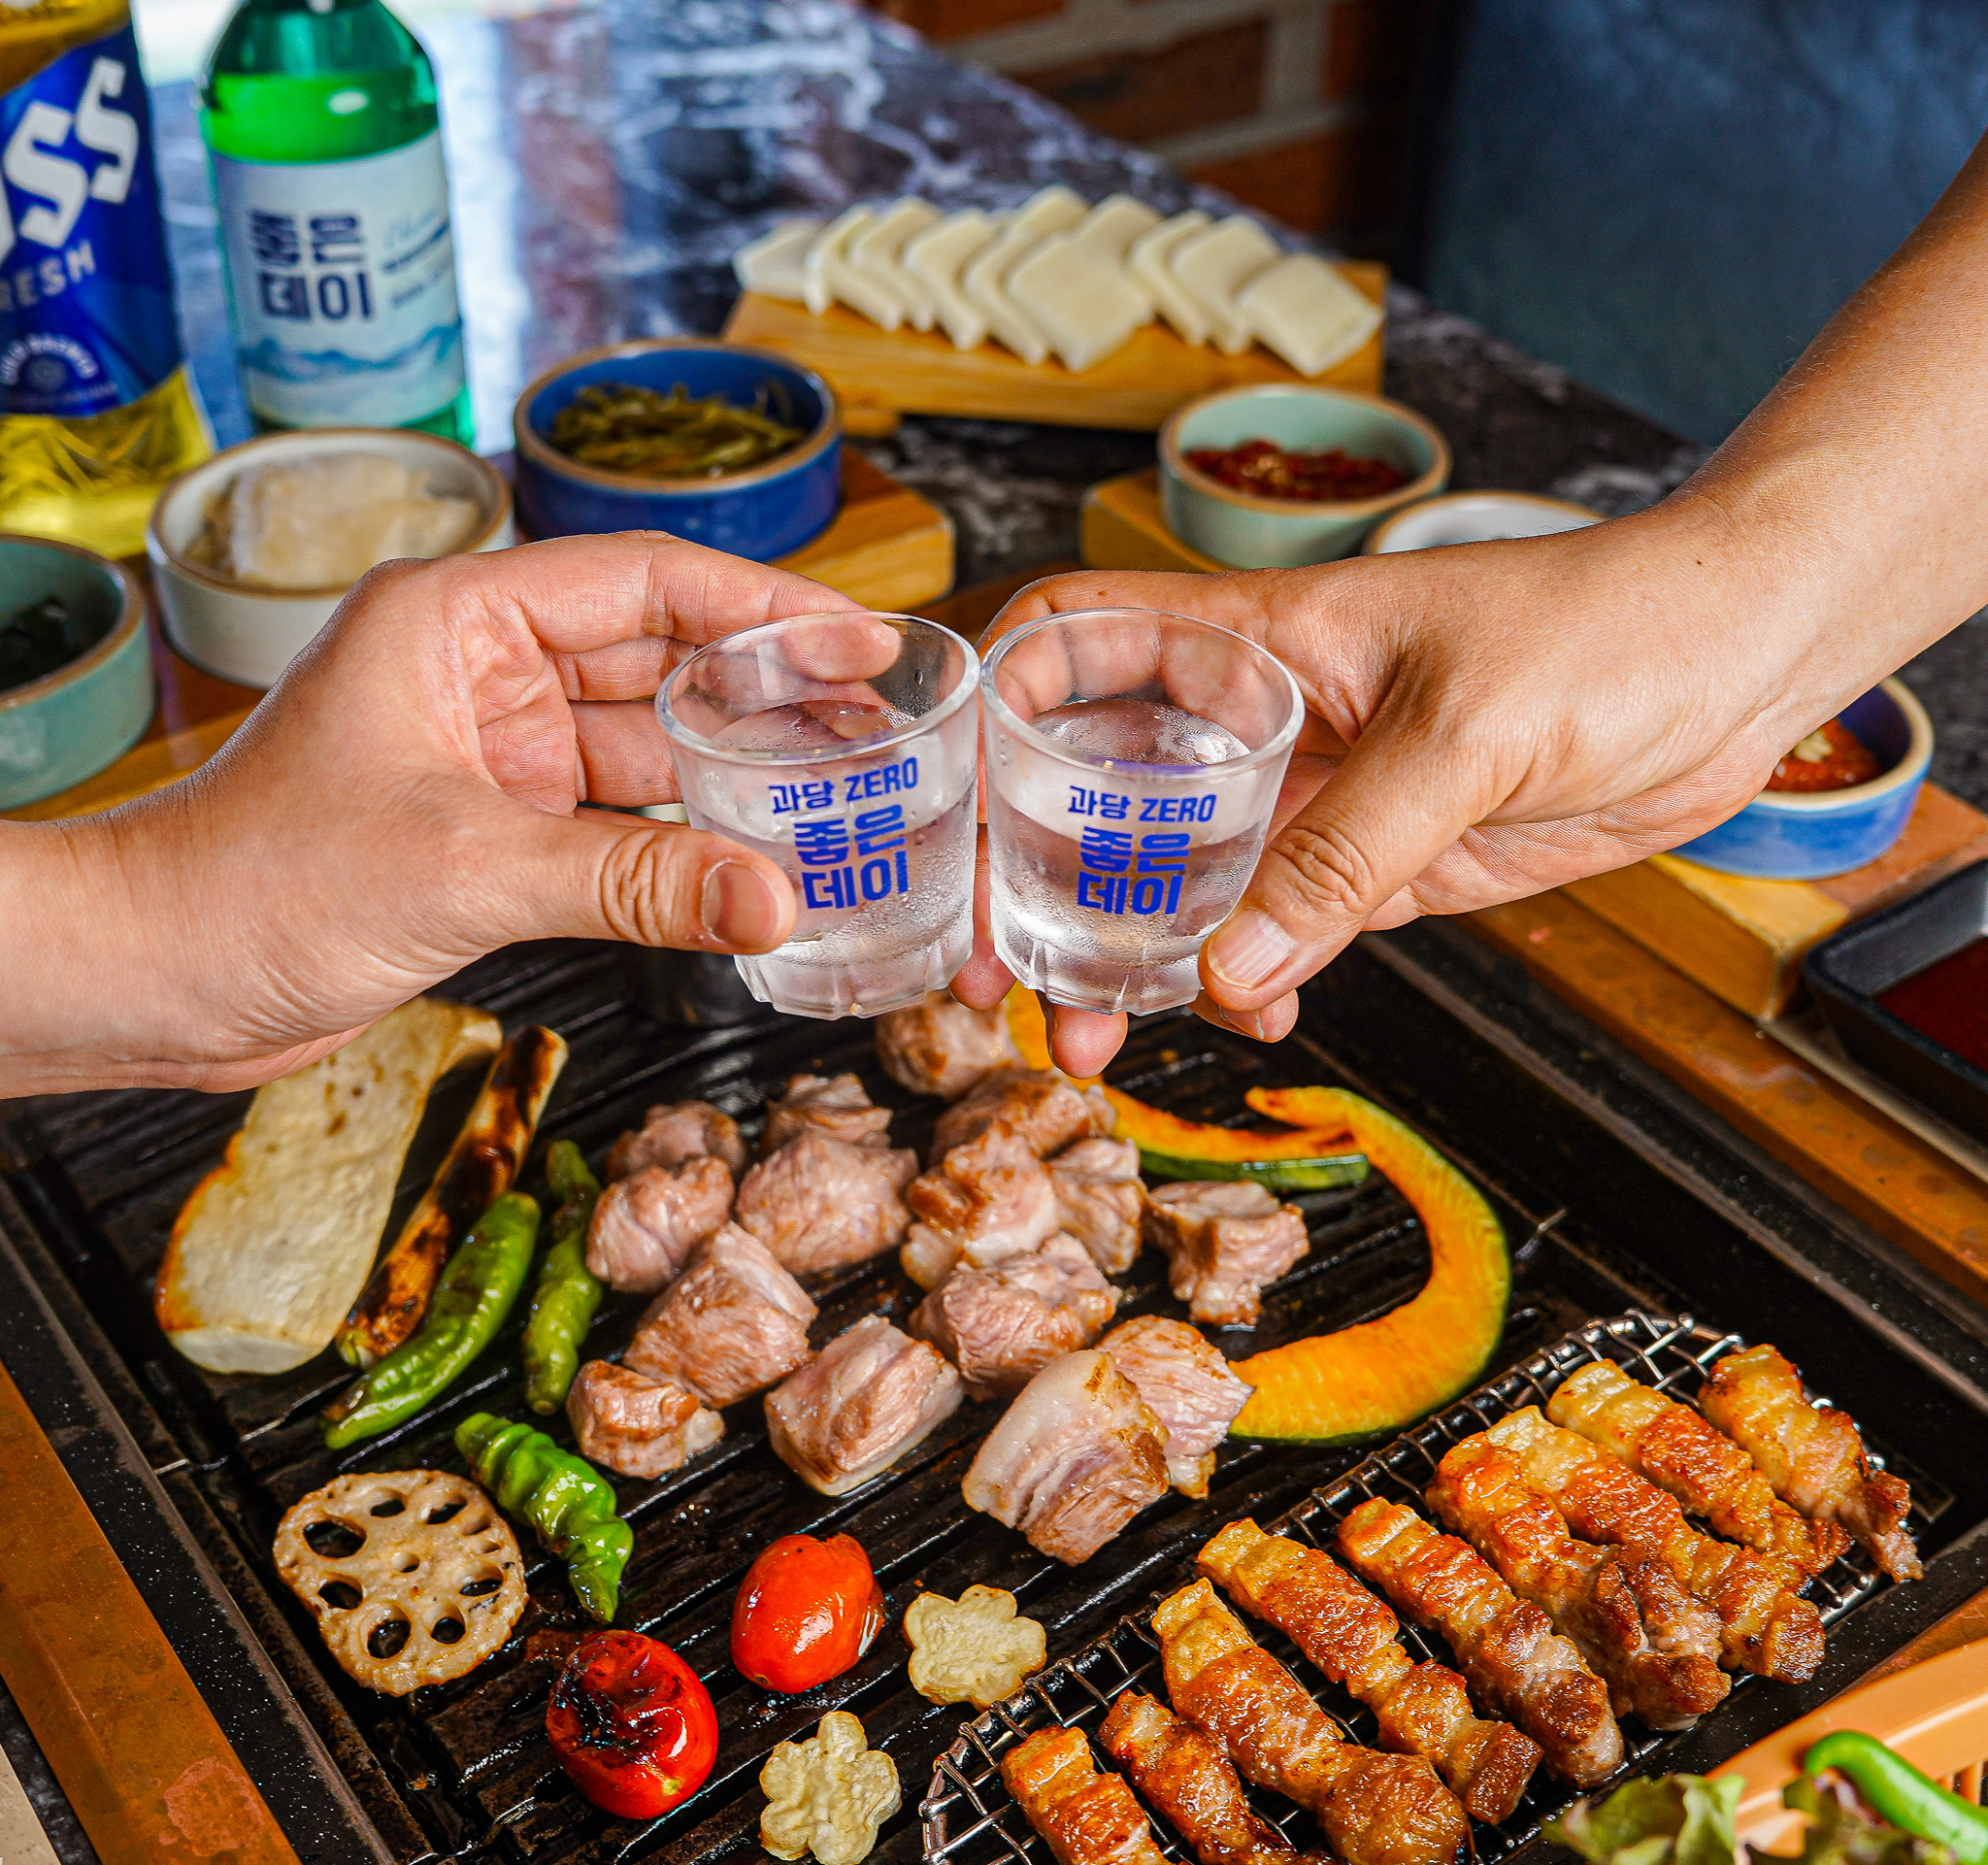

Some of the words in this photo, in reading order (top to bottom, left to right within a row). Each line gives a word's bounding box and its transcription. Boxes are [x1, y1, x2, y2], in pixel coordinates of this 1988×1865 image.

[259, 271, 372, 321] 데이
[768, 780, 835, 814] 과당
[844, 756, 917, 803] ZERO
[1068, 784, 1132, 820] 과당
[1138, 794, 1217, 823] ZERO
[794, 804, 907, 867] 좋은
[1079, 826, 1191, 874] 좋은
[801, 849, 910, 910] 데이
[1077, 871, 1183, 916] 데이
